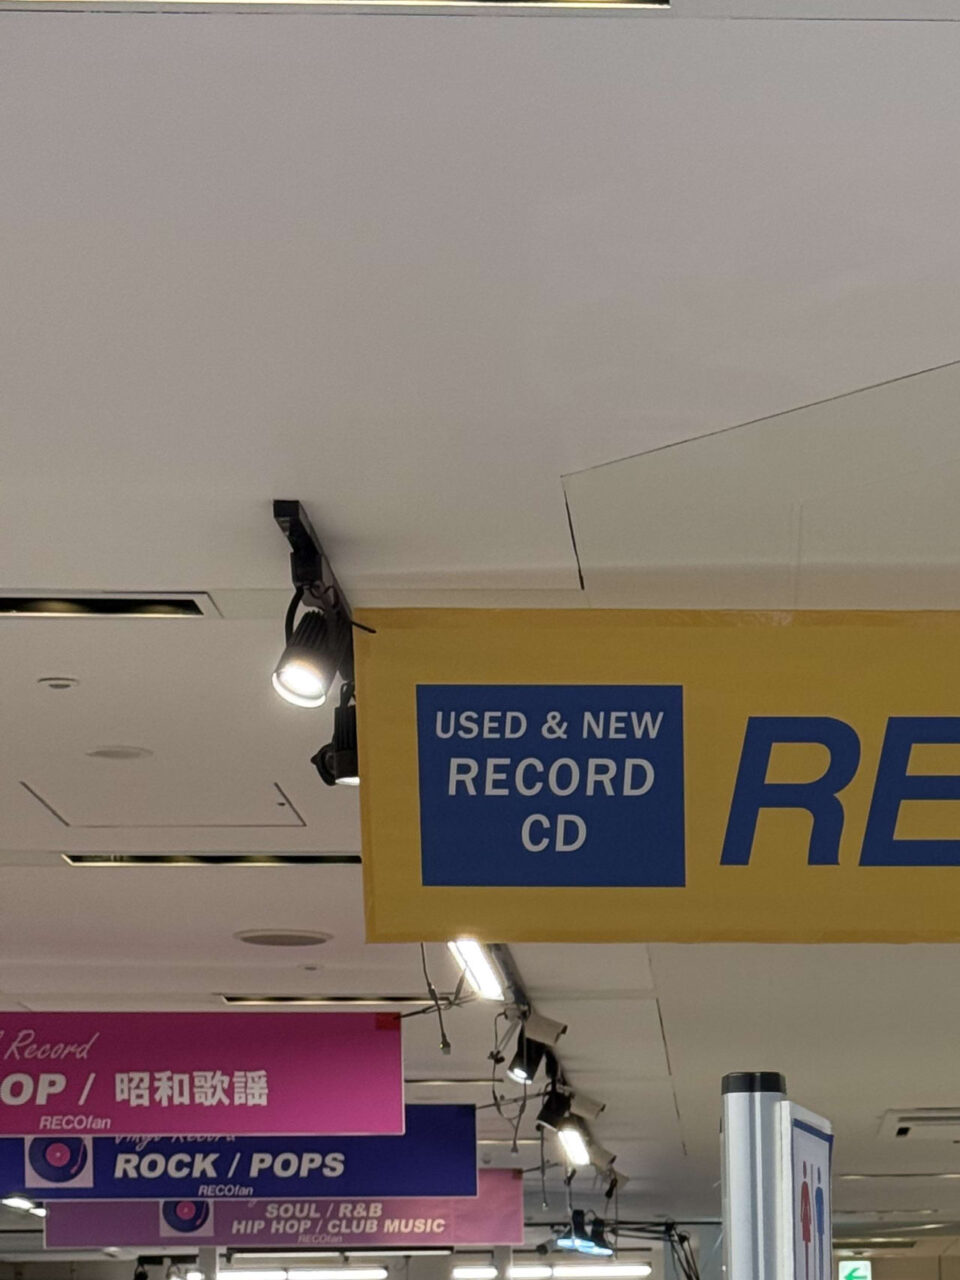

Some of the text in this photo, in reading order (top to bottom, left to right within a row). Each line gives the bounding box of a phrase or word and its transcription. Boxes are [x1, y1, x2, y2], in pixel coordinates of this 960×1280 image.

[435, 710, 664, 742] USED & NEW
[448, 758, 655, 798] RECORD
[521, 814, 588, 854] CD
[4, 1028, 100, 1061] Record
[79, 1073, 95, 1105] /
[114, 1069, 269, 1108] 昭和歌謡
[40, 1116, 111, 1131] RECOfan
[114, 1152, 346, 1179] ROCK / POPS
[198, 1184, 253, 1197] RECOfan
[265, 1203, 320, 1218] SOUL
[338, 1203, 383, 1218] R&B
[232, 1220, 265, 1235] HIP
[271, 1219, 310, 1234] HOP
[327, 1219, 379, 1234] CLUB
[383, 1218, 446, 1233] MUSIC
